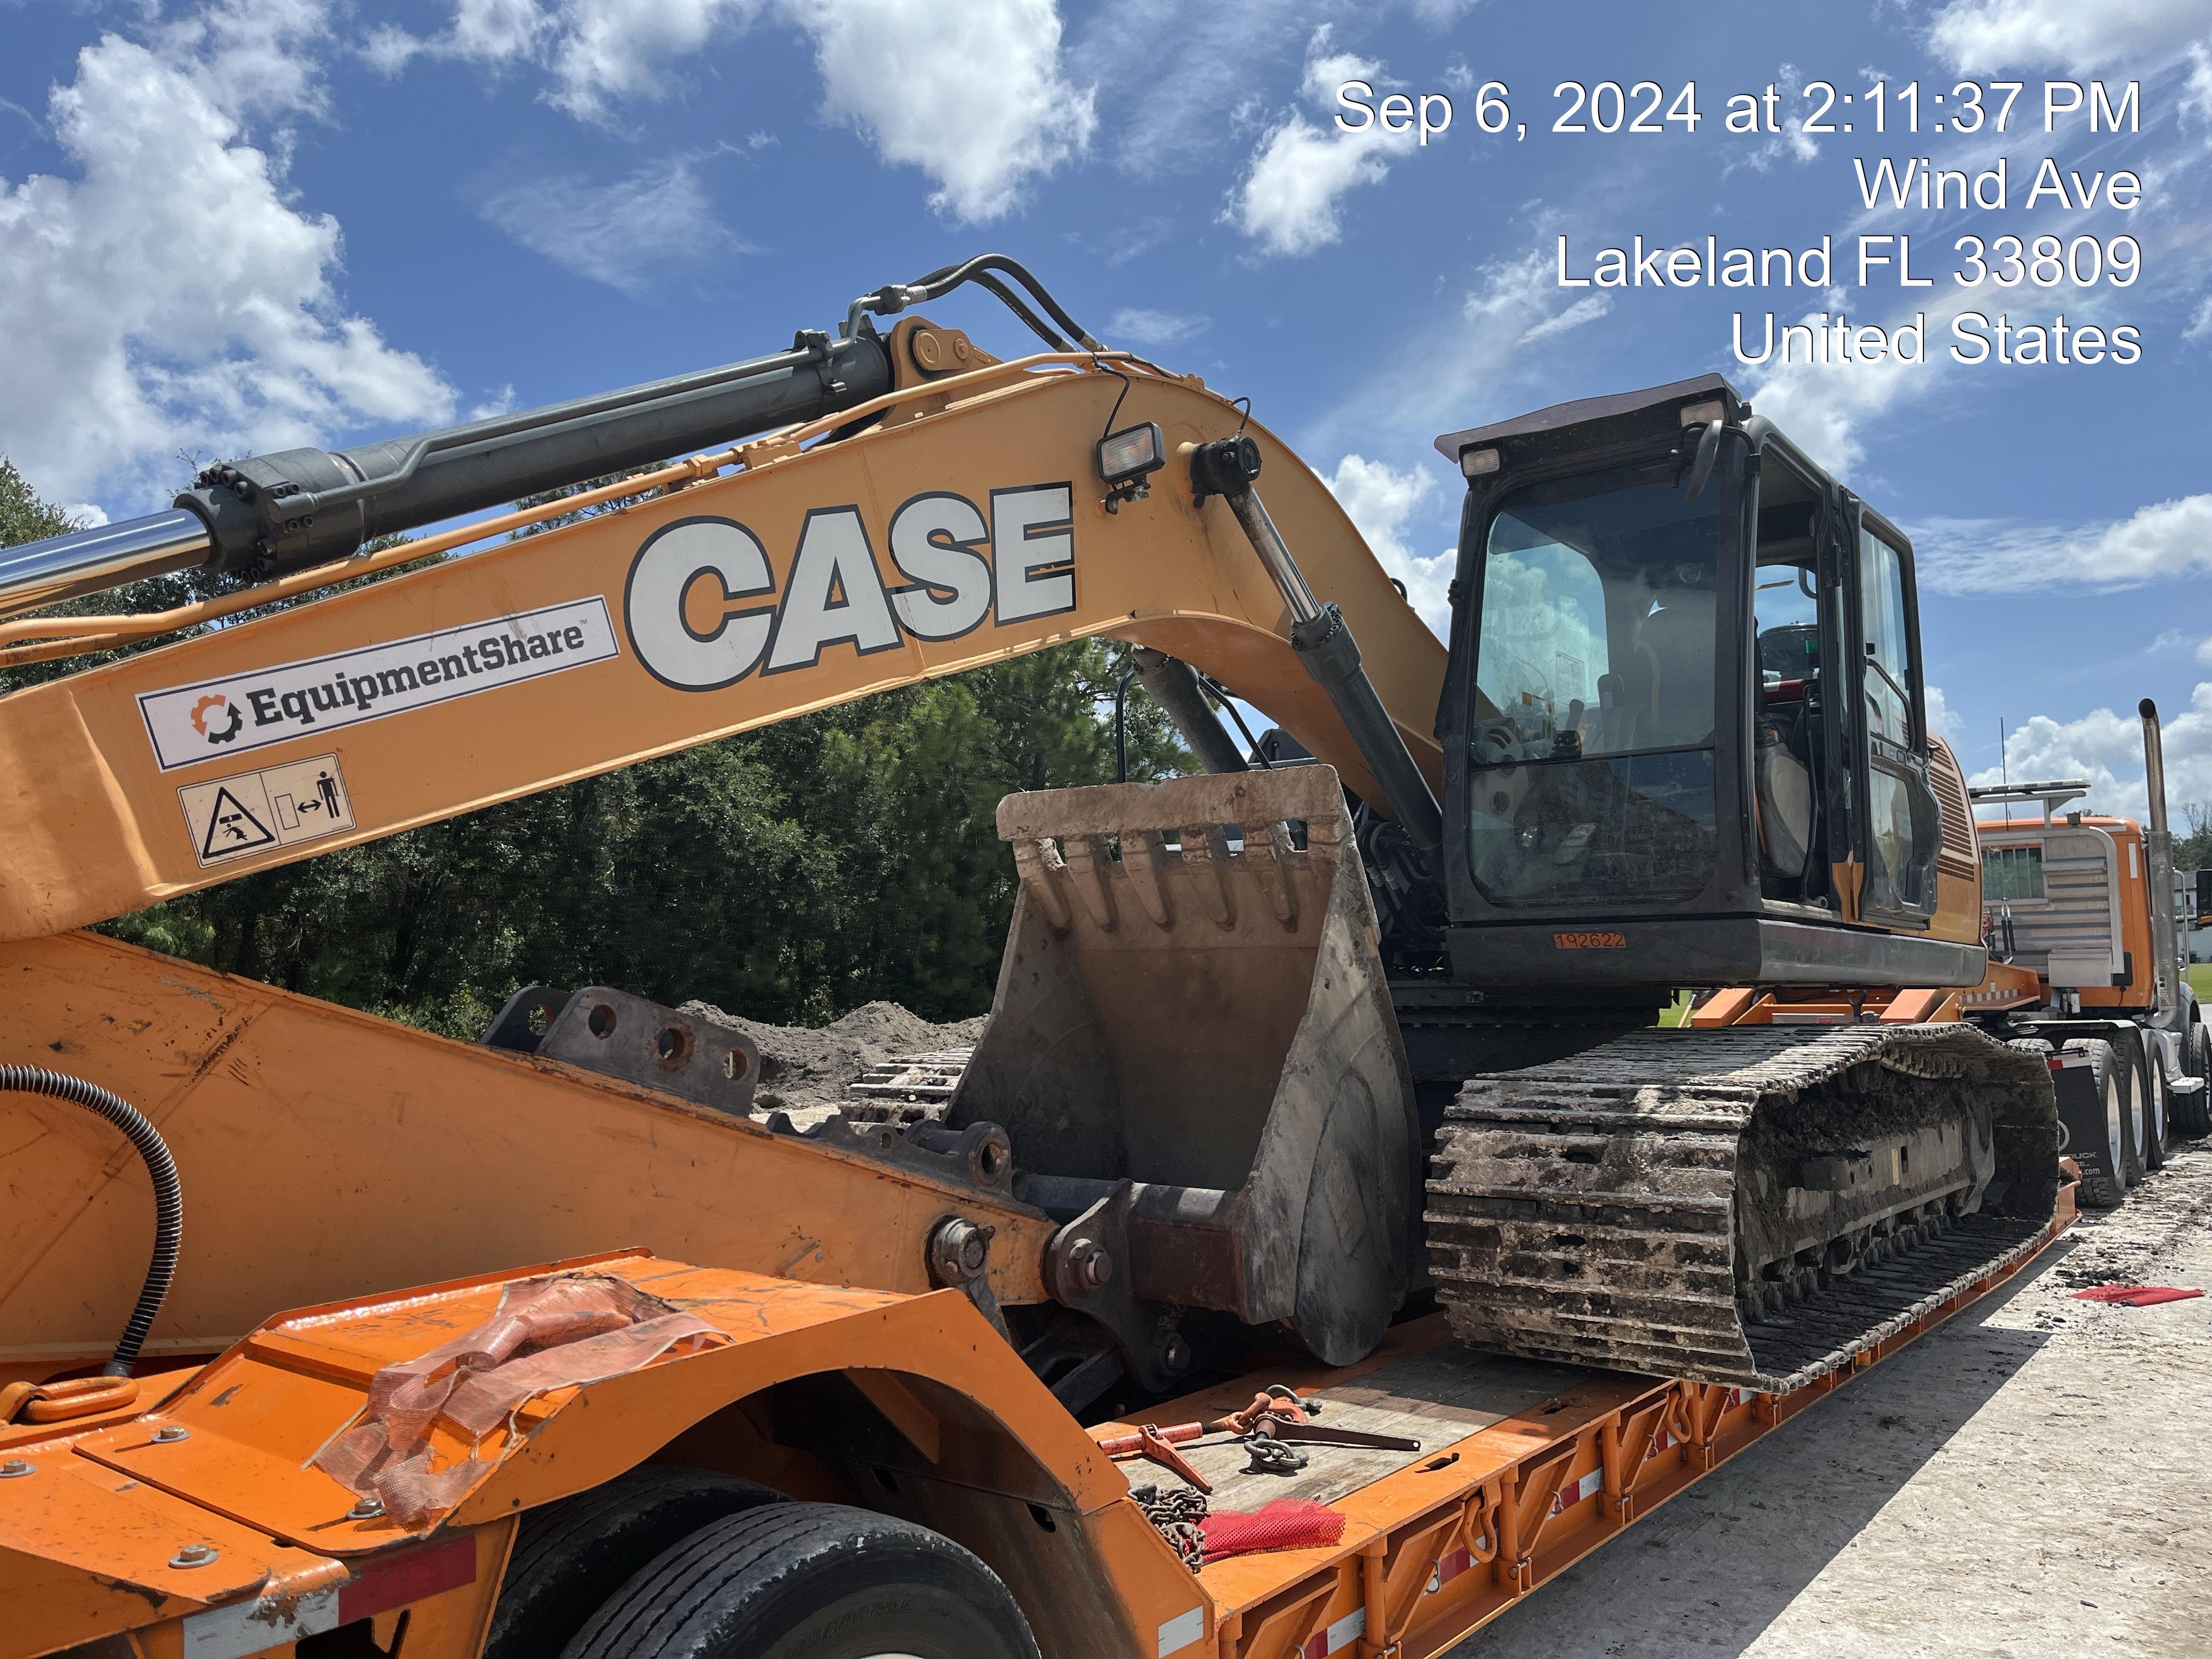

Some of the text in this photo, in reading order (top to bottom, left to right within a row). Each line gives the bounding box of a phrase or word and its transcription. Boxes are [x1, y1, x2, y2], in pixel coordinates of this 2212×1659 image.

[624, 481, 1076, 692] CASE
[246, 625, 585, 725] EquipmentShare
[1556, 933, 1625, 949] 192622
